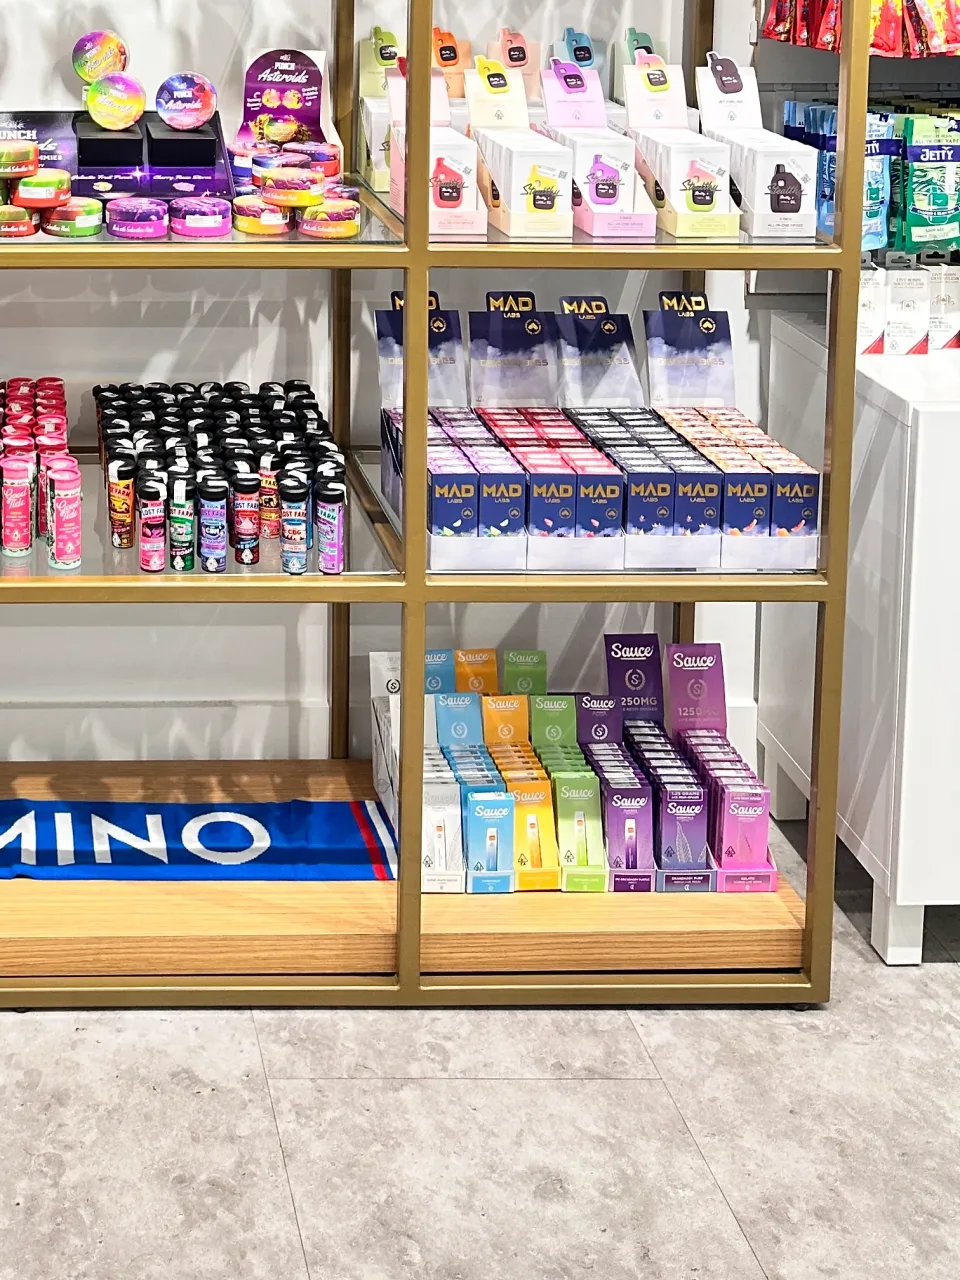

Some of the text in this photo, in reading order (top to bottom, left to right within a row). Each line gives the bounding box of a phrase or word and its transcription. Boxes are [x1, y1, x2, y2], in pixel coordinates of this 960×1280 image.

[274, 61, 296, 71] PUNCH
[257, 69, 309, 84] Asteroids
[173, 90, 193, 99] PUNCH
[163, 99, 203, 110] Asteroids
[920, 146, 955, 162] JETTY
[489, 296, 533, 311] MAD
[563, 300, 607, 314] MAD
[661, 295, 706, 311] MAD
[435, 483, 474, 498] MAD
[482, 483, 522, 497] MAD
[533, 483, 573, 498] MAD
[580, 483, 620, 498] MAD
[457, 651, 490, 662] Sauce
[611, 642, 654, 658] Sauce
[508, 652, 540, 663] Sauce
[672, 652, 717, 668] Sauce
[438, 694, 472, 706] Sauce
[487, 697, 520, 709] Sauce
[535, 697, 568, 709] Sauce
[581, 696, 616, 709] Sauce
[513, 789, 546, 802] Sauce
[560, 786, 594, 798] Sauce
